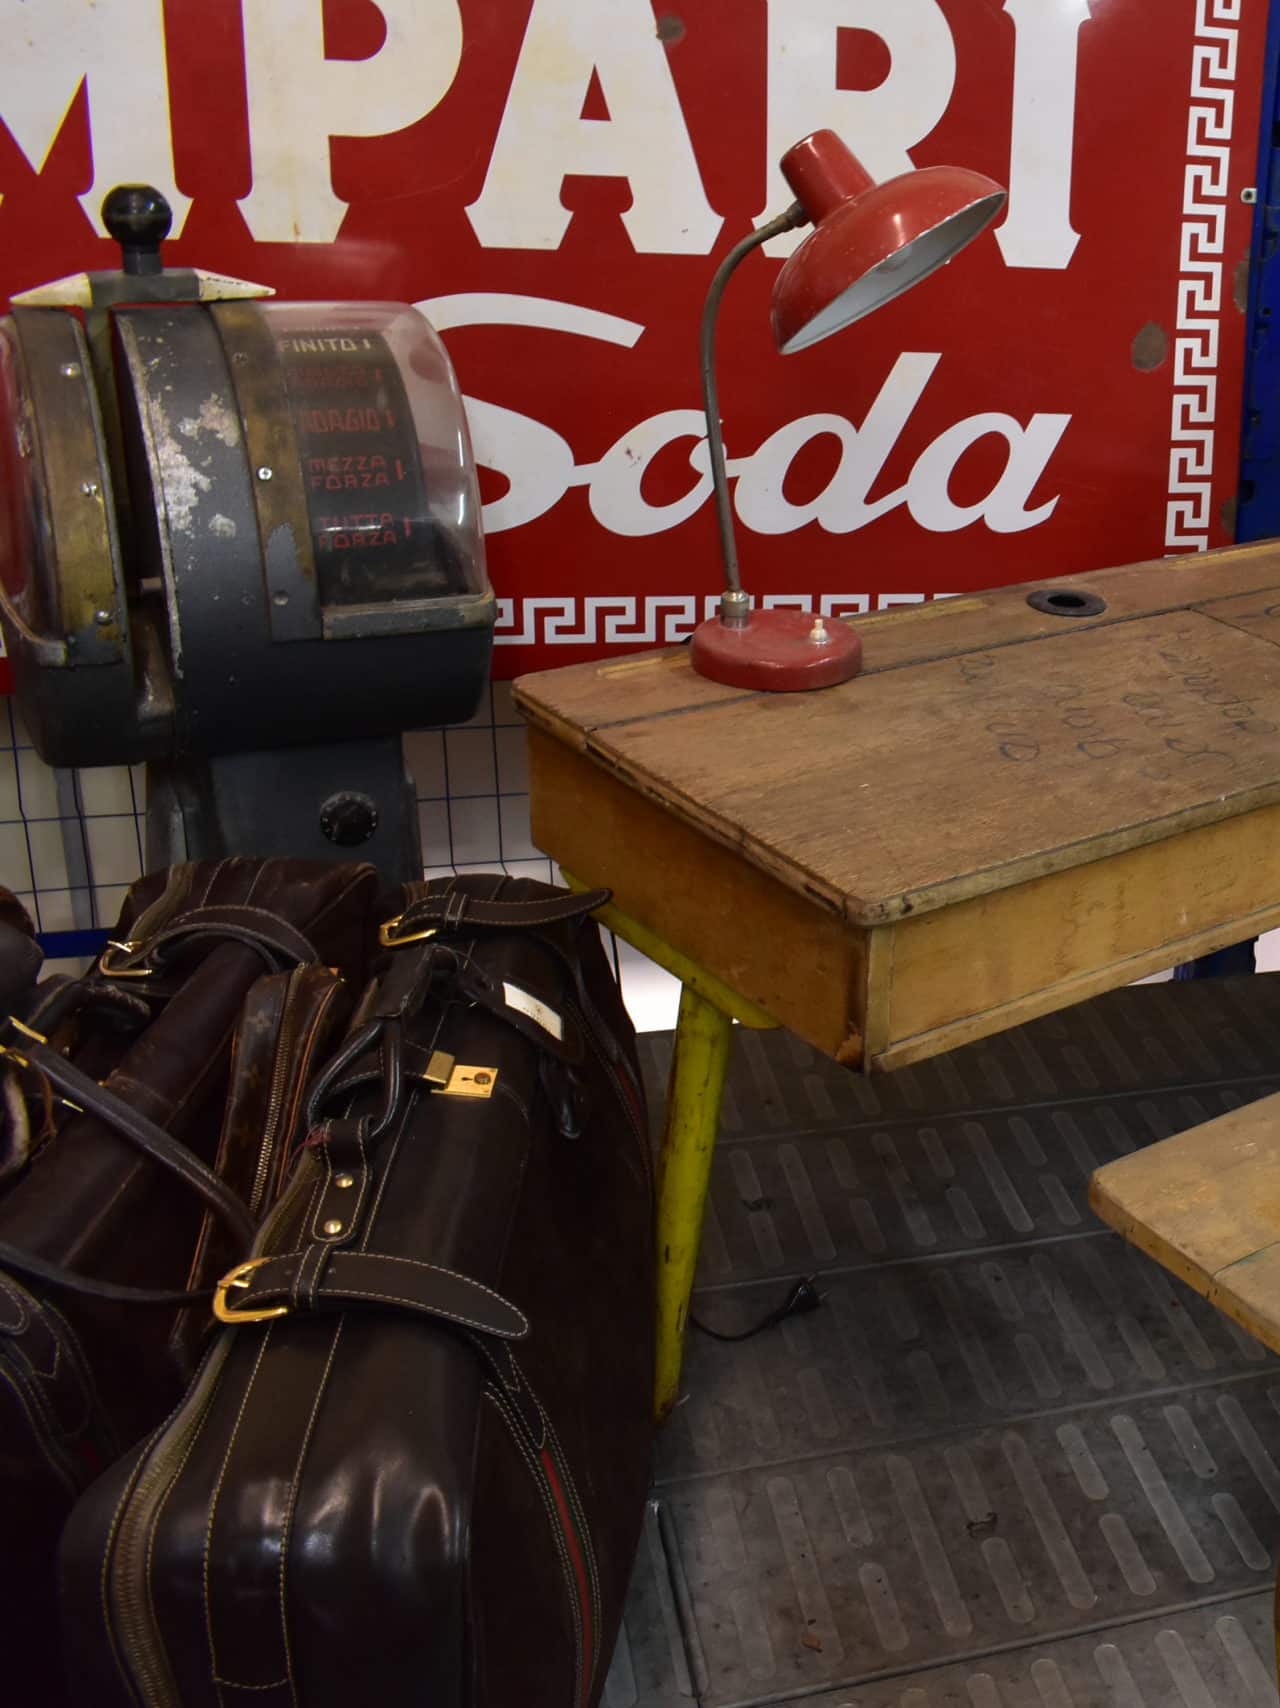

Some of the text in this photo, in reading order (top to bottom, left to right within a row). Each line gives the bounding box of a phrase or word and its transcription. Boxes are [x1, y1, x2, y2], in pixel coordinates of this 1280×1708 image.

[277, 337, 358, 352] FINITO
[410, 292, 1072, 537] Soda
[309, 455, 386, 472] MEZZA
[309, 472, 390, 490] FORZA
[319, 512, 394, 529] TUTTA
[318, 530, 398, 549] FORZA
